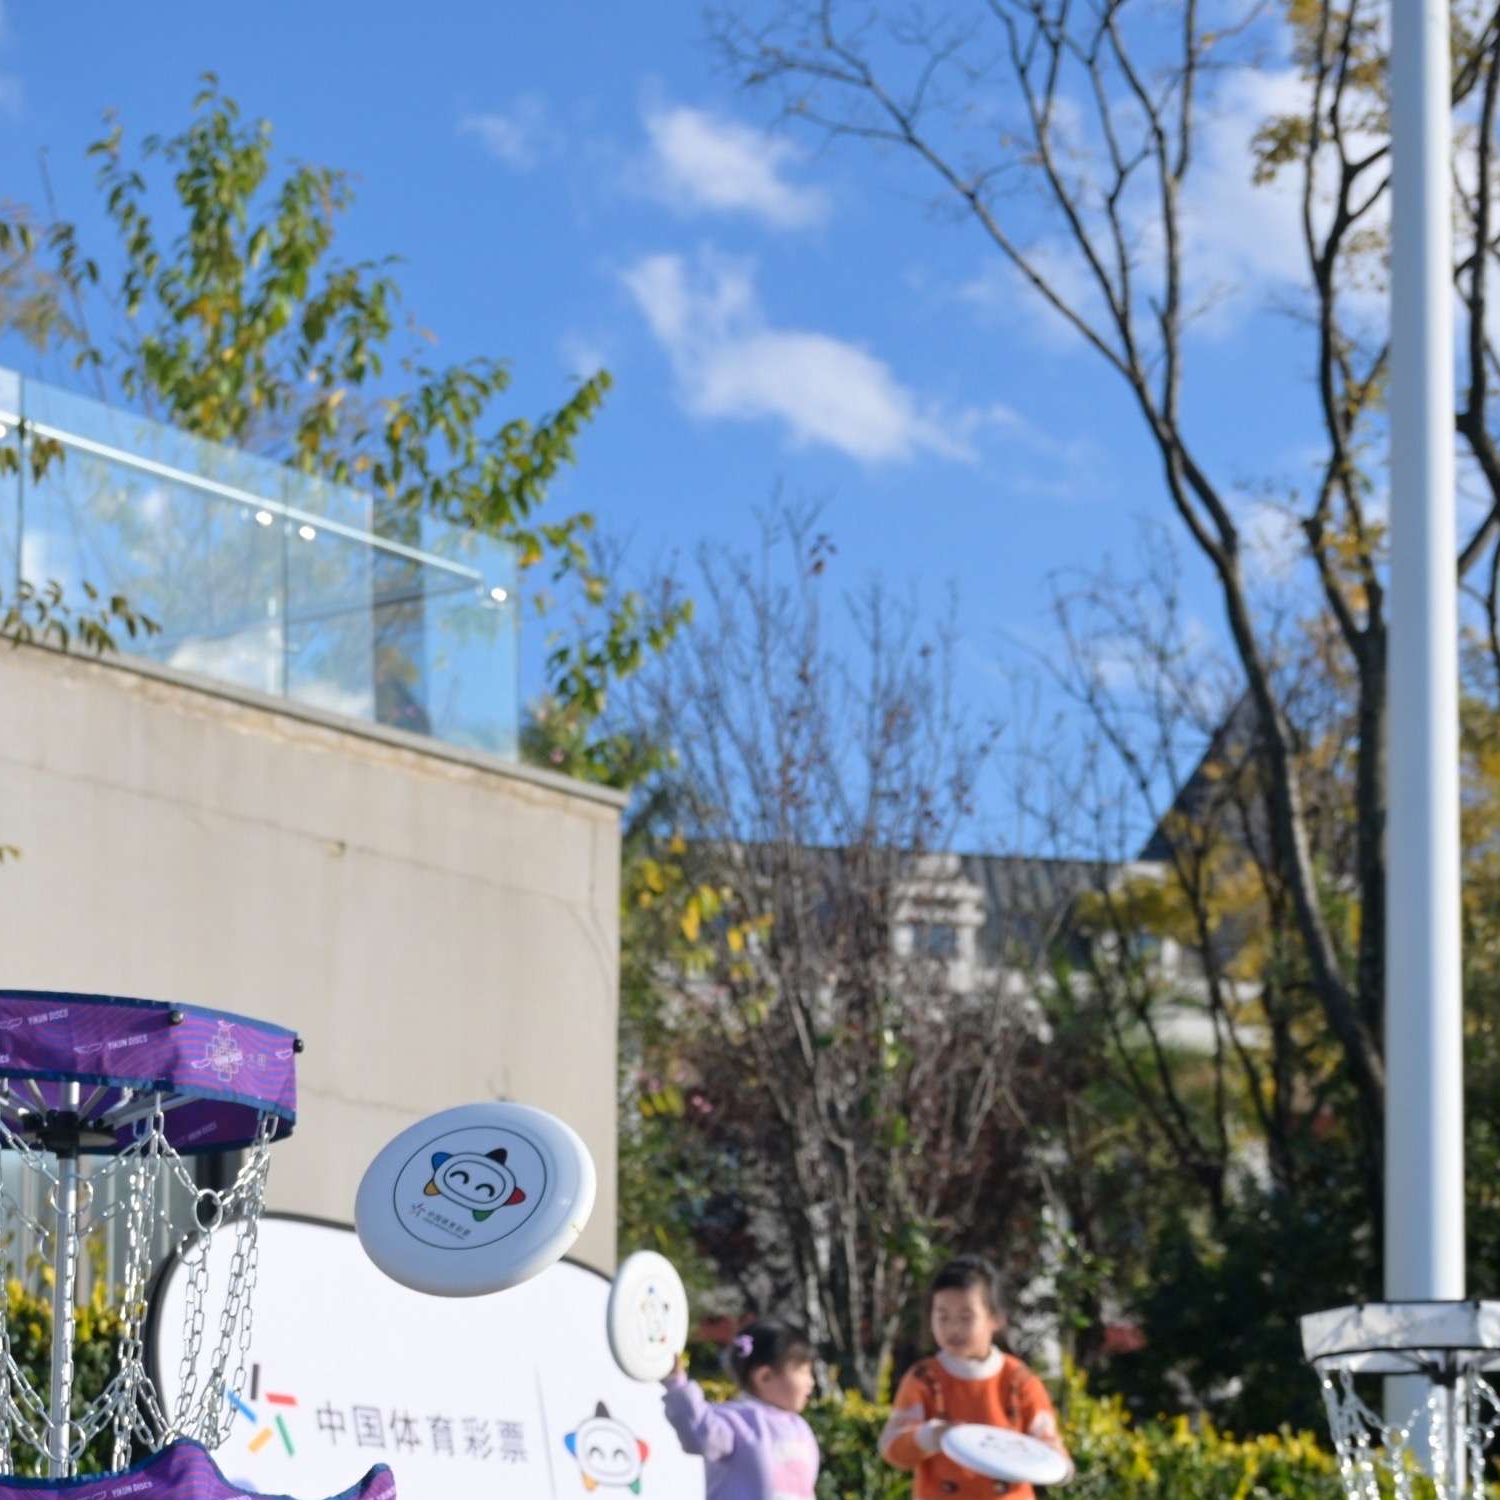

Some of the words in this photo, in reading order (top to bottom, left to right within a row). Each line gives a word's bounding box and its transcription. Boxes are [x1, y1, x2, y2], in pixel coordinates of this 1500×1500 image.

[316, 1400, 529, 1460] 中国体育彩票
